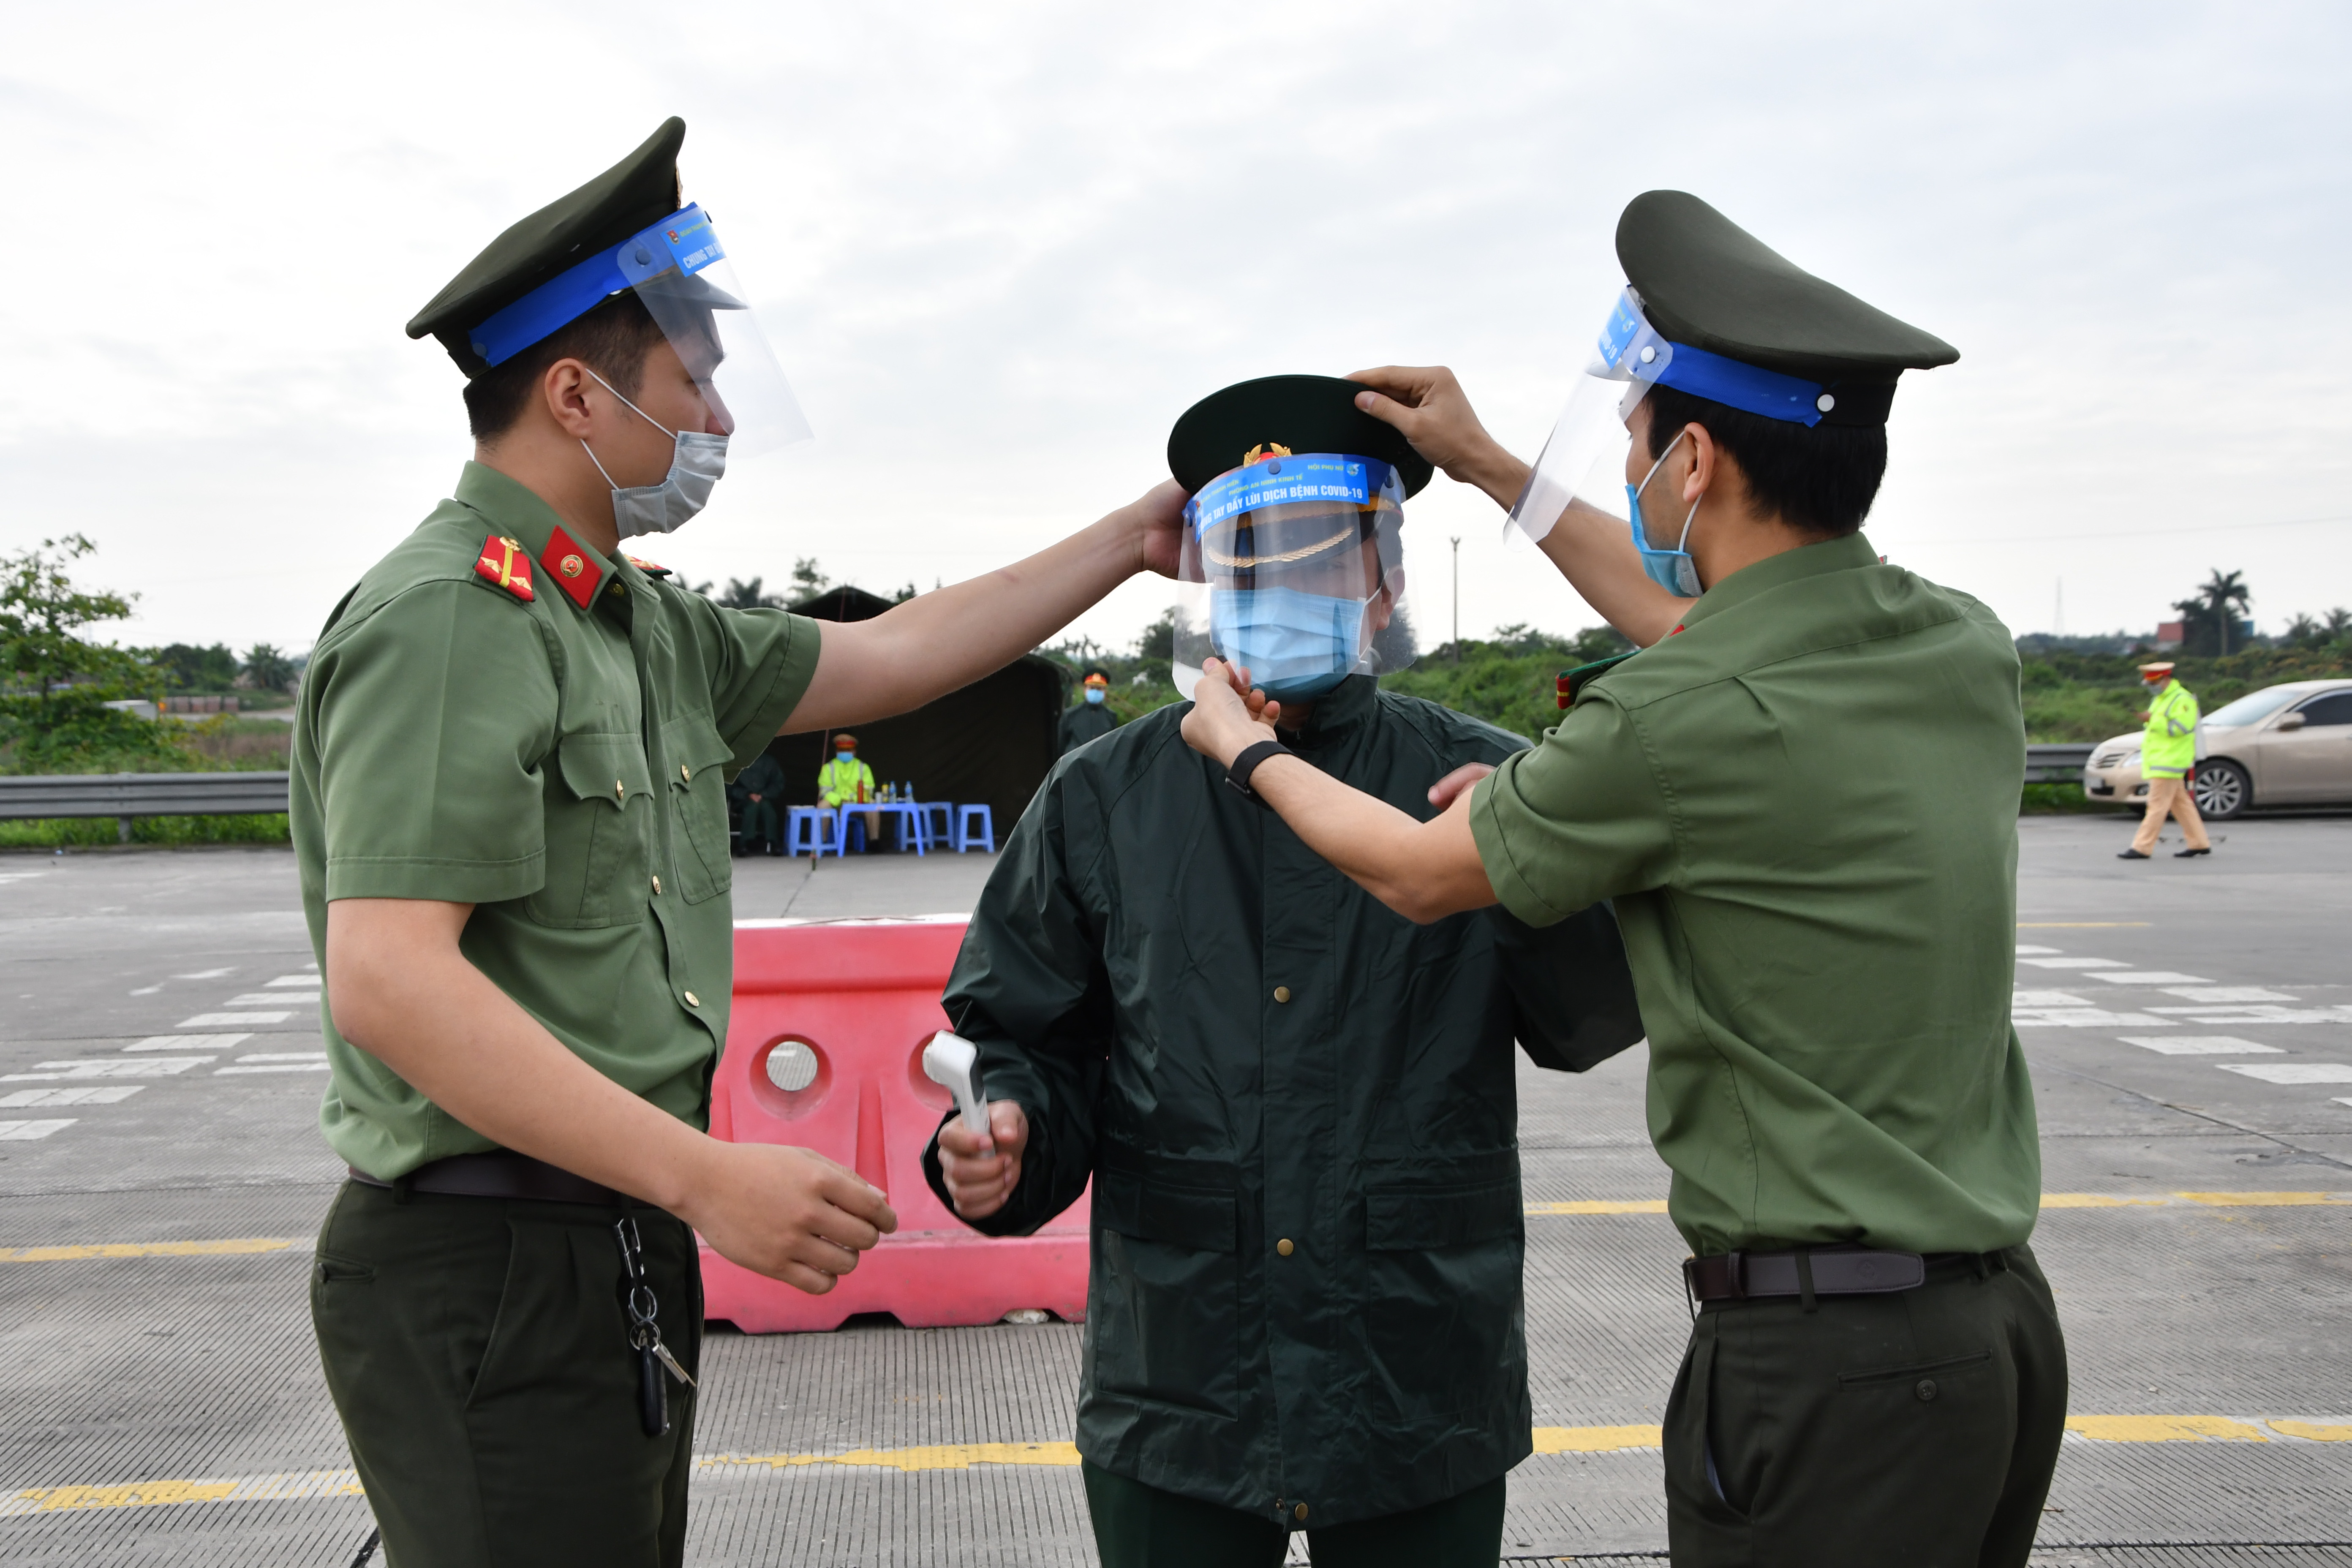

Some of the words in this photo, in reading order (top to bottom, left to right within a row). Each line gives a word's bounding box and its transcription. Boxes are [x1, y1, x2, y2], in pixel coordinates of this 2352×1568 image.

[683, 248, 708, 269] CHUNG
[1213, 506, 1224, 520] TAY
[1263, 488, 1287, 502] DỊCH
[1290, 484, 1318, 499] BỆNH
[1320, 485, 1363, 499] COVID-19
